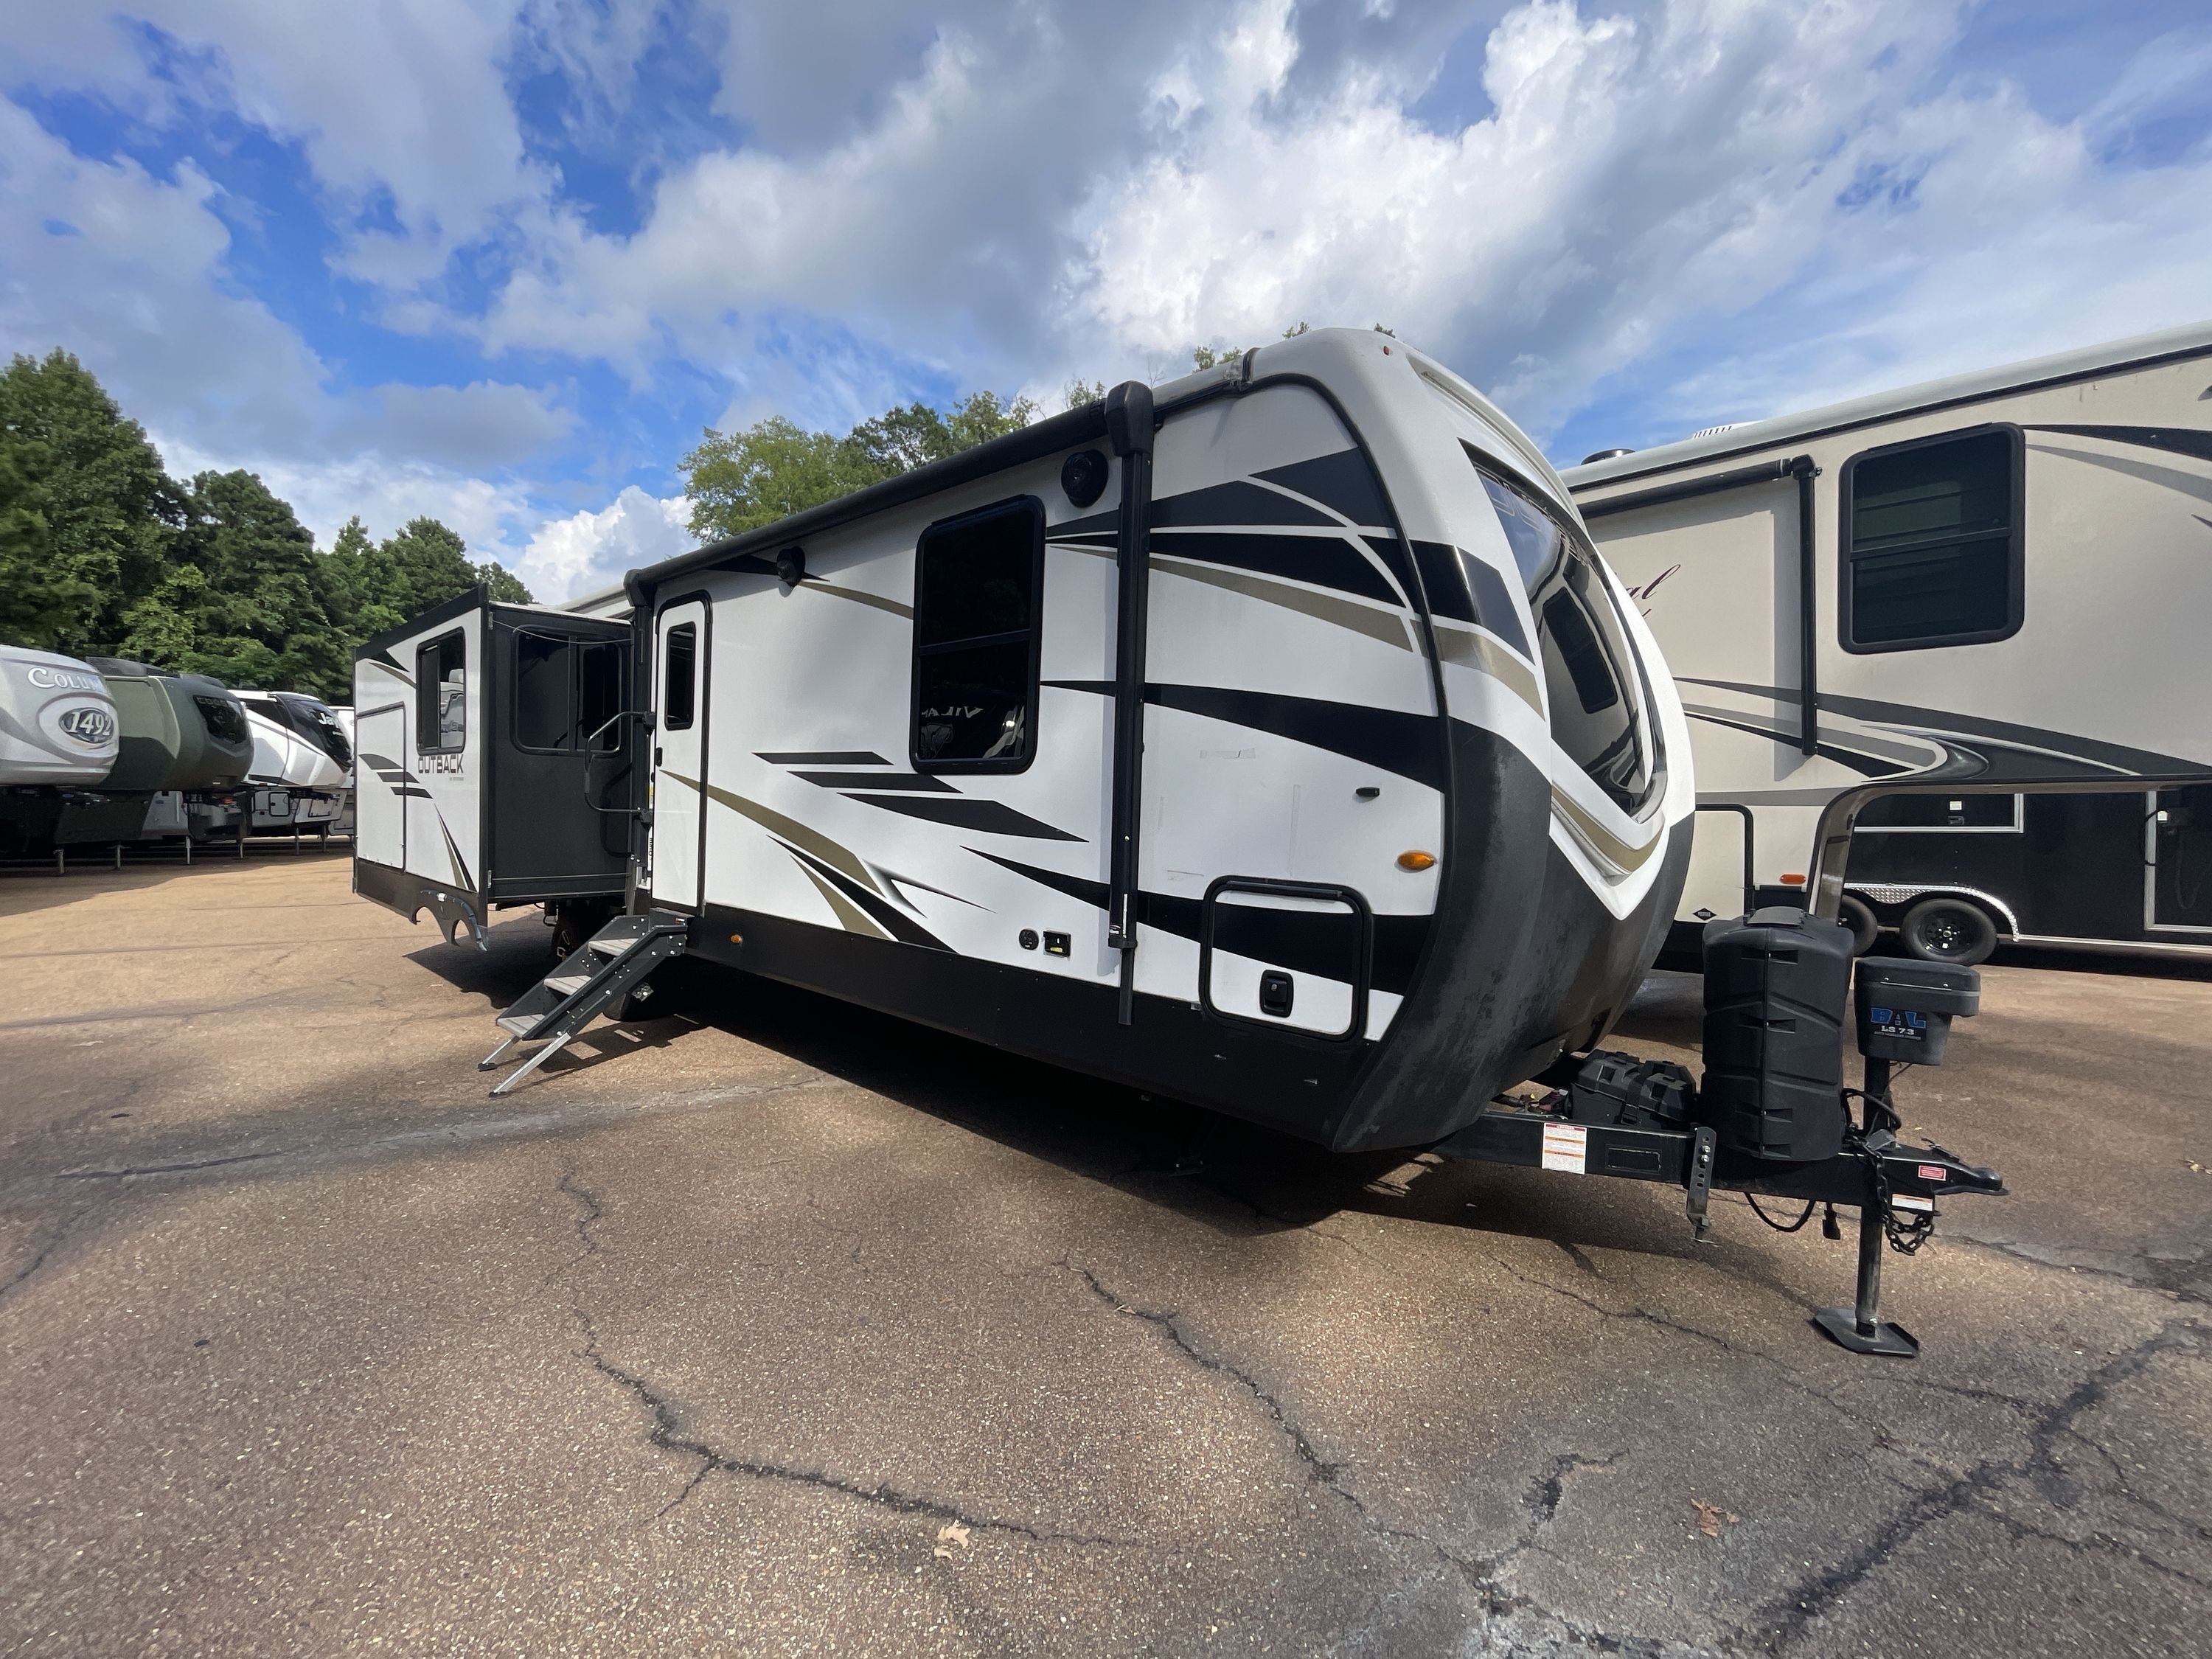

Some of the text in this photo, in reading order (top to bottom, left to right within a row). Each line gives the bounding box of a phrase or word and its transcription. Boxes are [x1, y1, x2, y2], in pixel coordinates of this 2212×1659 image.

[68, 712, 113, 736] 1492
[418, 754, 465, 773] OUTBACK
[1898, 1027, 1915, 1035] 73
